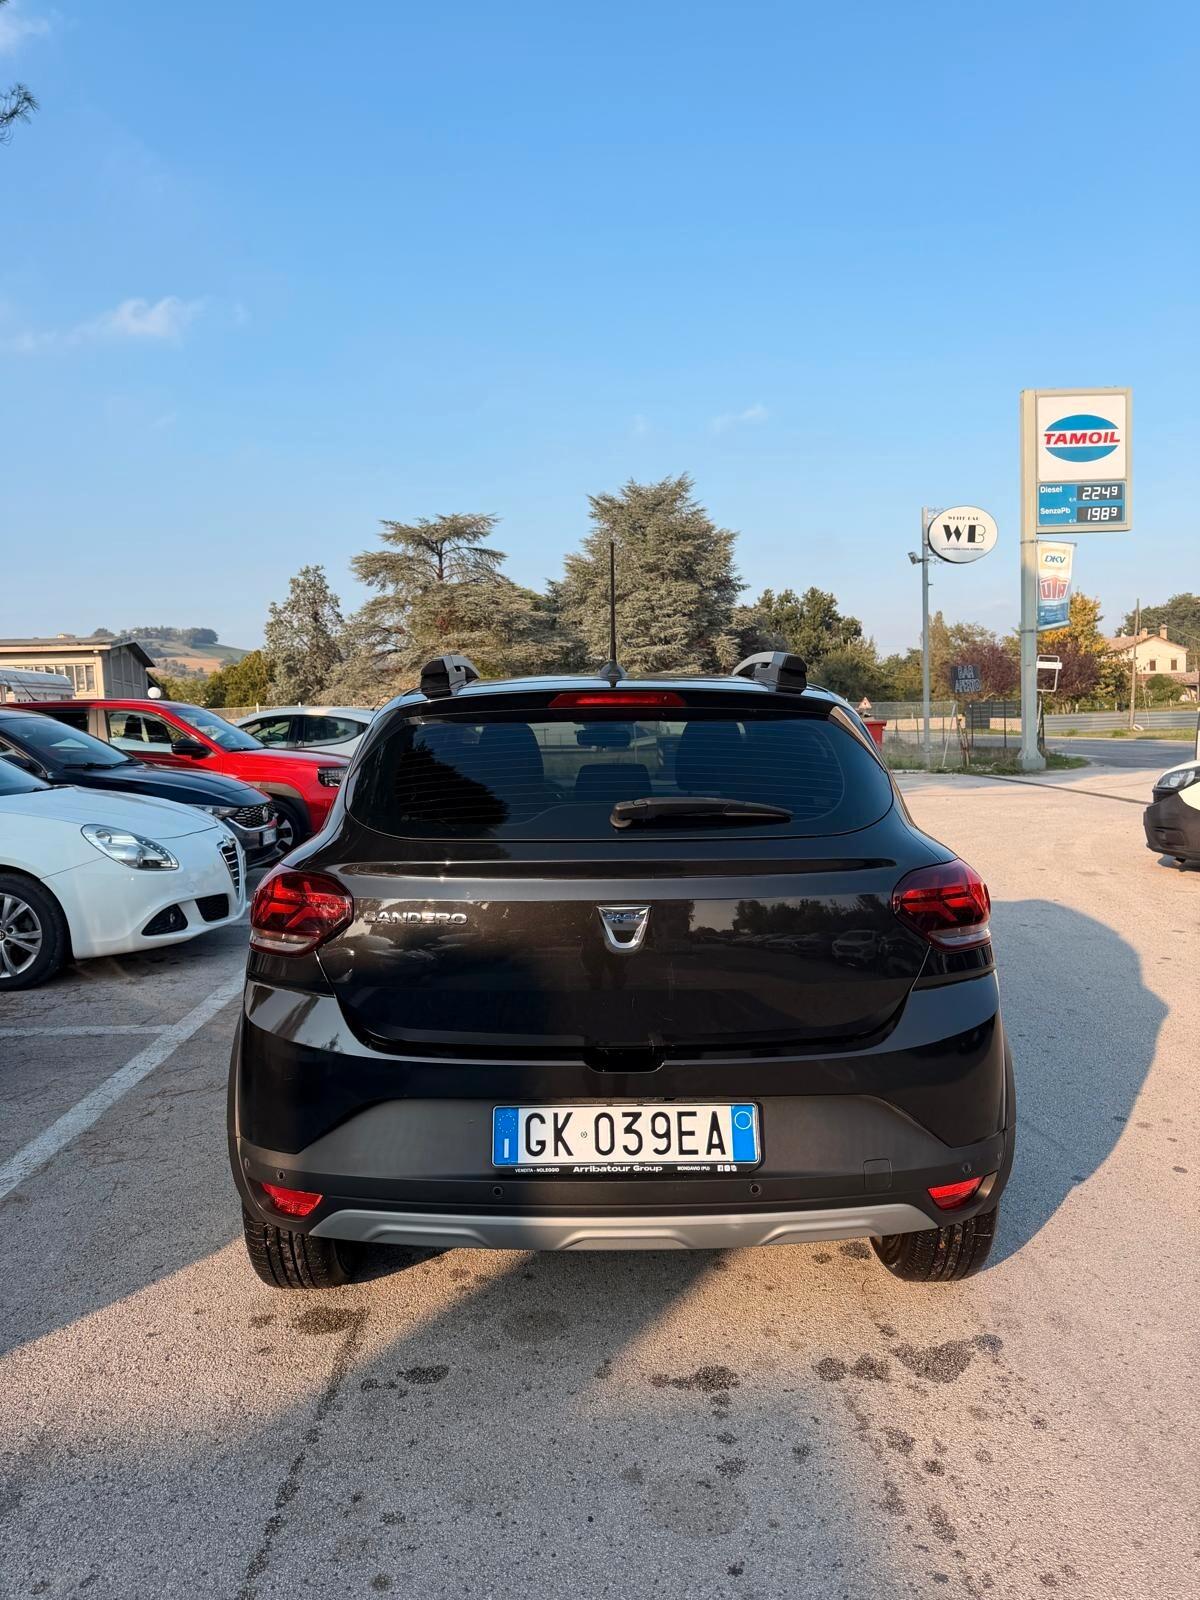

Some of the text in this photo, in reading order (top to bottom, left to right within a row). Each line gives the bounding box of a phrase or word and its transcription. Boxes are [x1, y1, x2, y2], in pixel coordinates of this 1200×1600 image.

[1043, 431, 1121, 445] TAMOIL
[1082, 486, 1118, 500] 2249
[1040, 507, 1071, 515] SenzaPb
[1087, 507, 1118, 520] 1989
[942, 524, 986, 543] WB
[1045, 555, 1066, 563] DKV
[957, 665, 975, 679] BAR
[363, 911, 469, 925] SANDERO
[525, 1111, 727, 1157] GK 039EA
[573, 1165, 631, 1173] Arribatour
